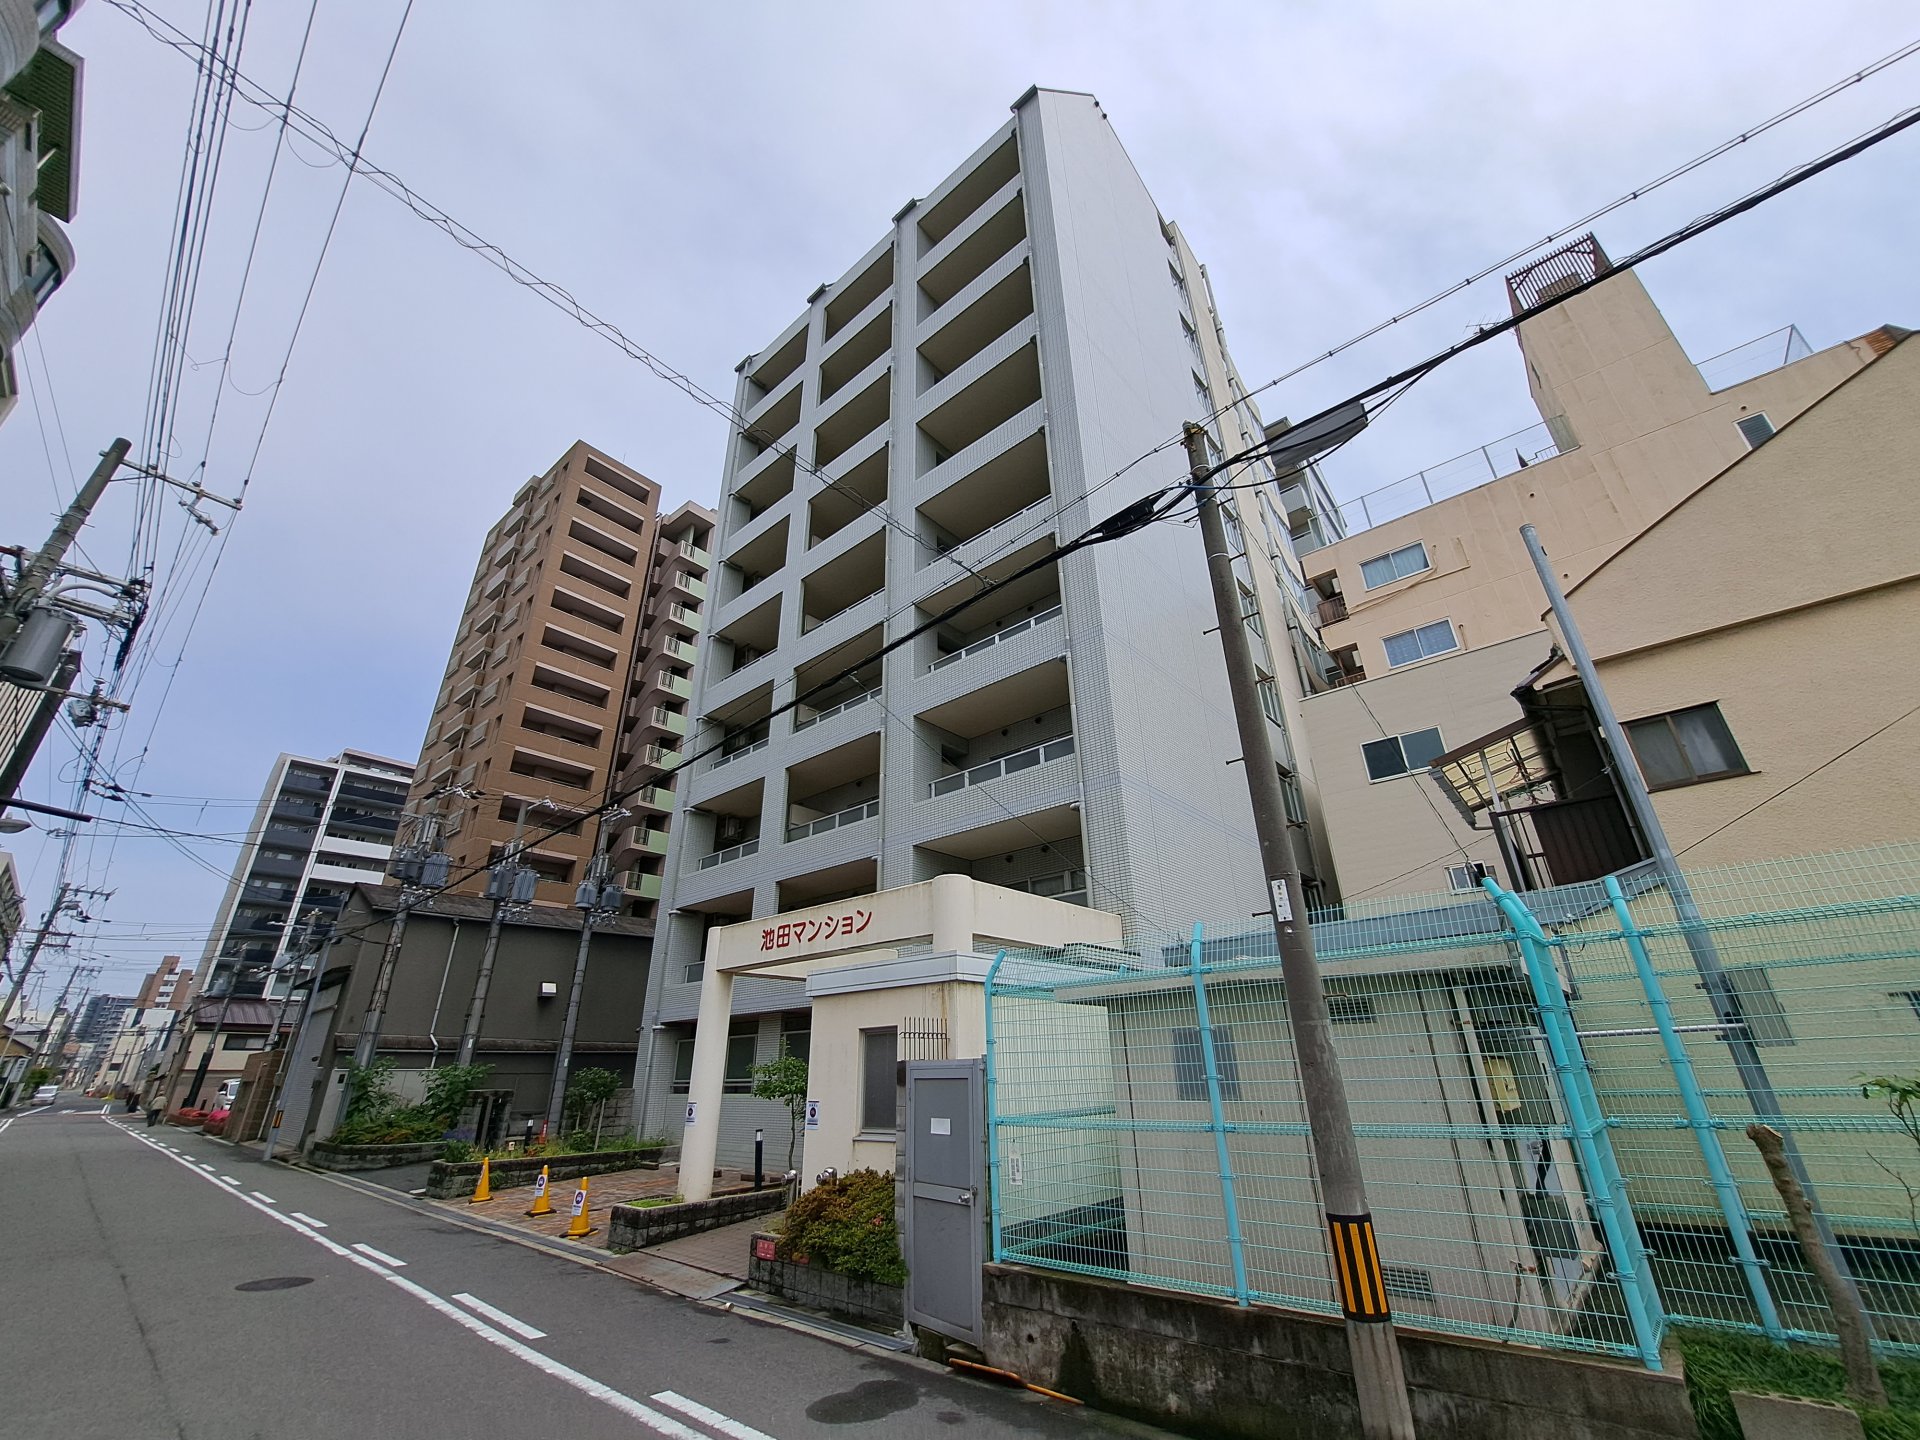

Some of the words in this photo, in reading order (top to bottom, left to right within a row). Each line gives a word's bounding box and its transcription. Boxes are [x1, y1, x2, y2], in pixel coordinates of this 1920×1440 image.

[760, 909, 873, 952] 池田マンション
